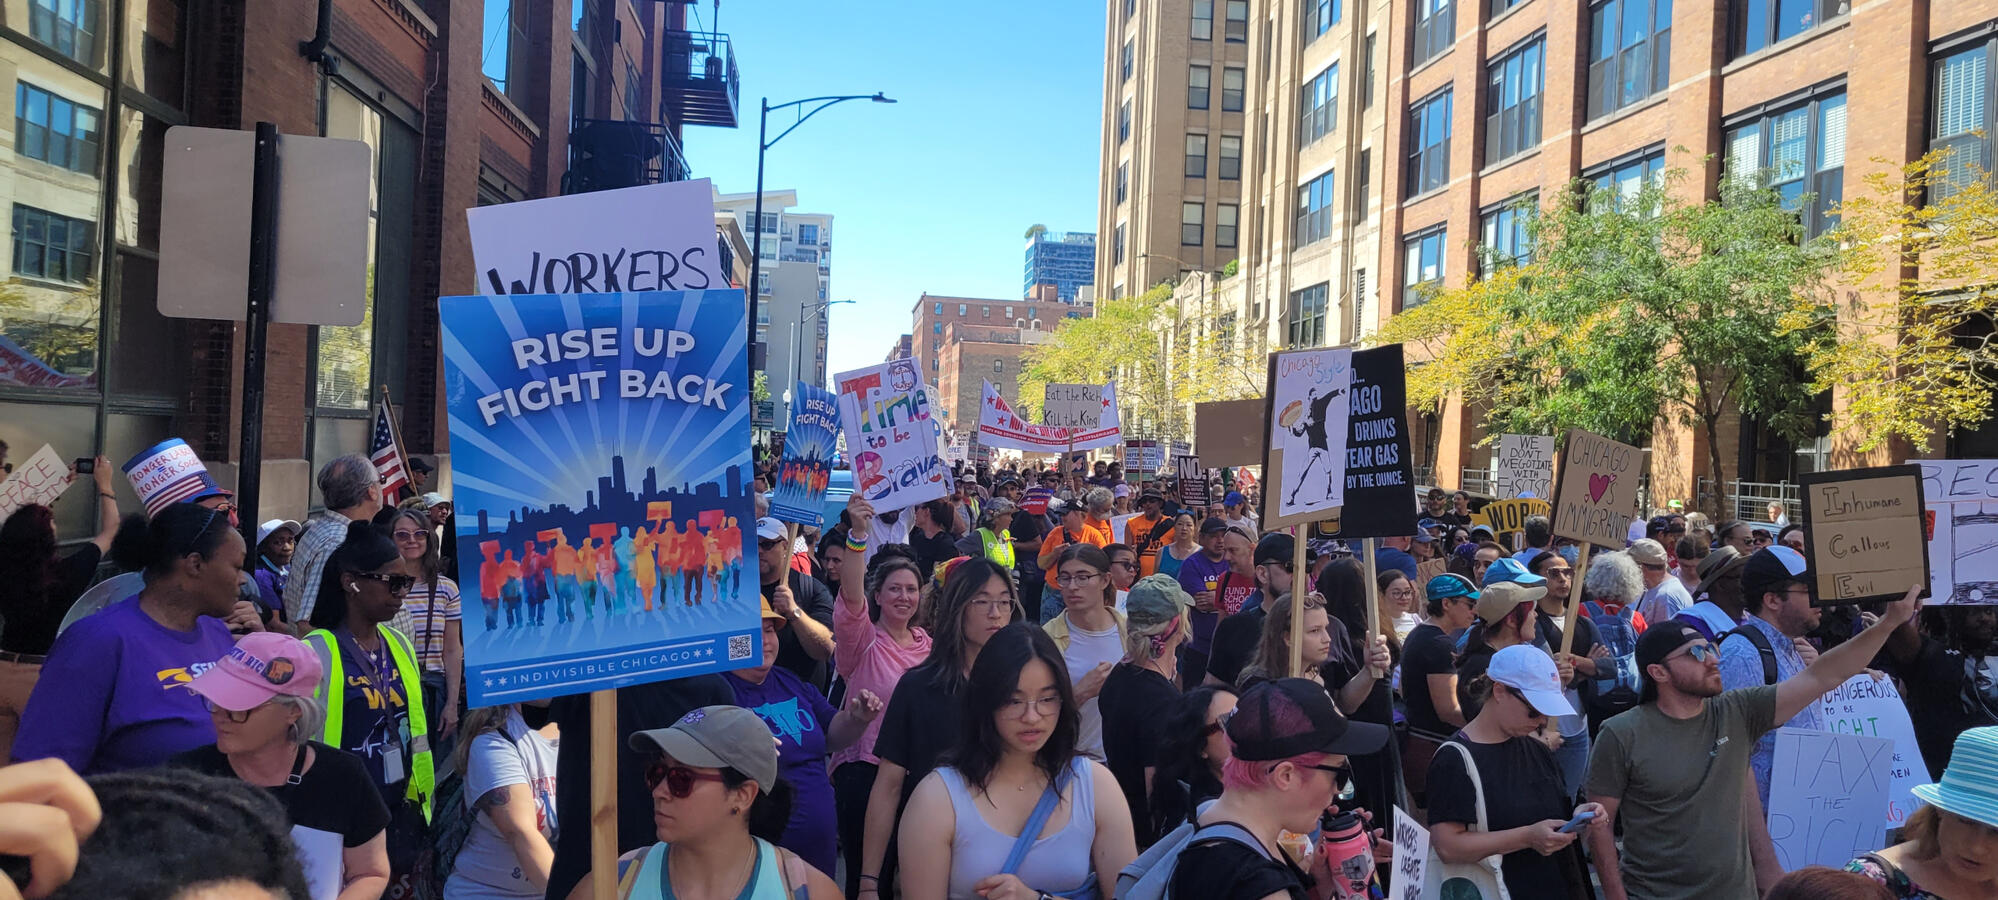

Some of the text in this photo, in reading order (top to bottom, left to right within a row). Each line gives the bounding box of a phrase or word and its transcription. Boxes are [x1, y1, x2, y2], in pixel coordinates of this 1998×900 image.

[488, 247, 709, 296] WORKERS
[512, 327, 696, 370] RISE UP
[1281, 354, 1320, 378] Chicago
[476, 369, 733, 426] FIGHT BACK
[840, 371, 931, 432] Time
[1045, 386, 1101, 402] Eat the Rich
[1350, 385, 1382, 416] AGO
[806, 399, 836, 417] RISE UP
[1044, 410, 1098, 429] Kill the King
[796, 413, 838, 437] FIGHT BACK
[866, 427, 911, 449] to be
[1355, 417, 1397, 442] DRINKS
[1346, 443, 1399, 469] TEAR GAS
[1519, 436, 1539, 450] WE
[1572, 436, 1631, 473] CHICAGO
[130, 455, 171, 485] RONGER
[854, 451, 942, 500] Brave
[1499, 459, 1553, 471] NEGOTIATE
[1512, 469, 1540, 479] WITH
[137, 466, 180, 499] RONGER
[1347, 470, 1406, 489] BY THE OUNCE.
[1822, 486, 1902, 517] Inhumane
[1558, 502, 1631, 543] IMMIGRANTS
[1829, 533, 1890, 559] Callous
[1837, 574, 1875, 599] Evil
[513, 650, 691, 684] INDIVISIBLE CHICAGO
[1824, 680, 1899, 703] DANGEROUS
[1825, 706, 1855, 716] TO BE
[1780, 733, 1887, 794] TAX
[1804, 796, 1851, 811] THE
[1770, 813, 1880, 872] RICH
